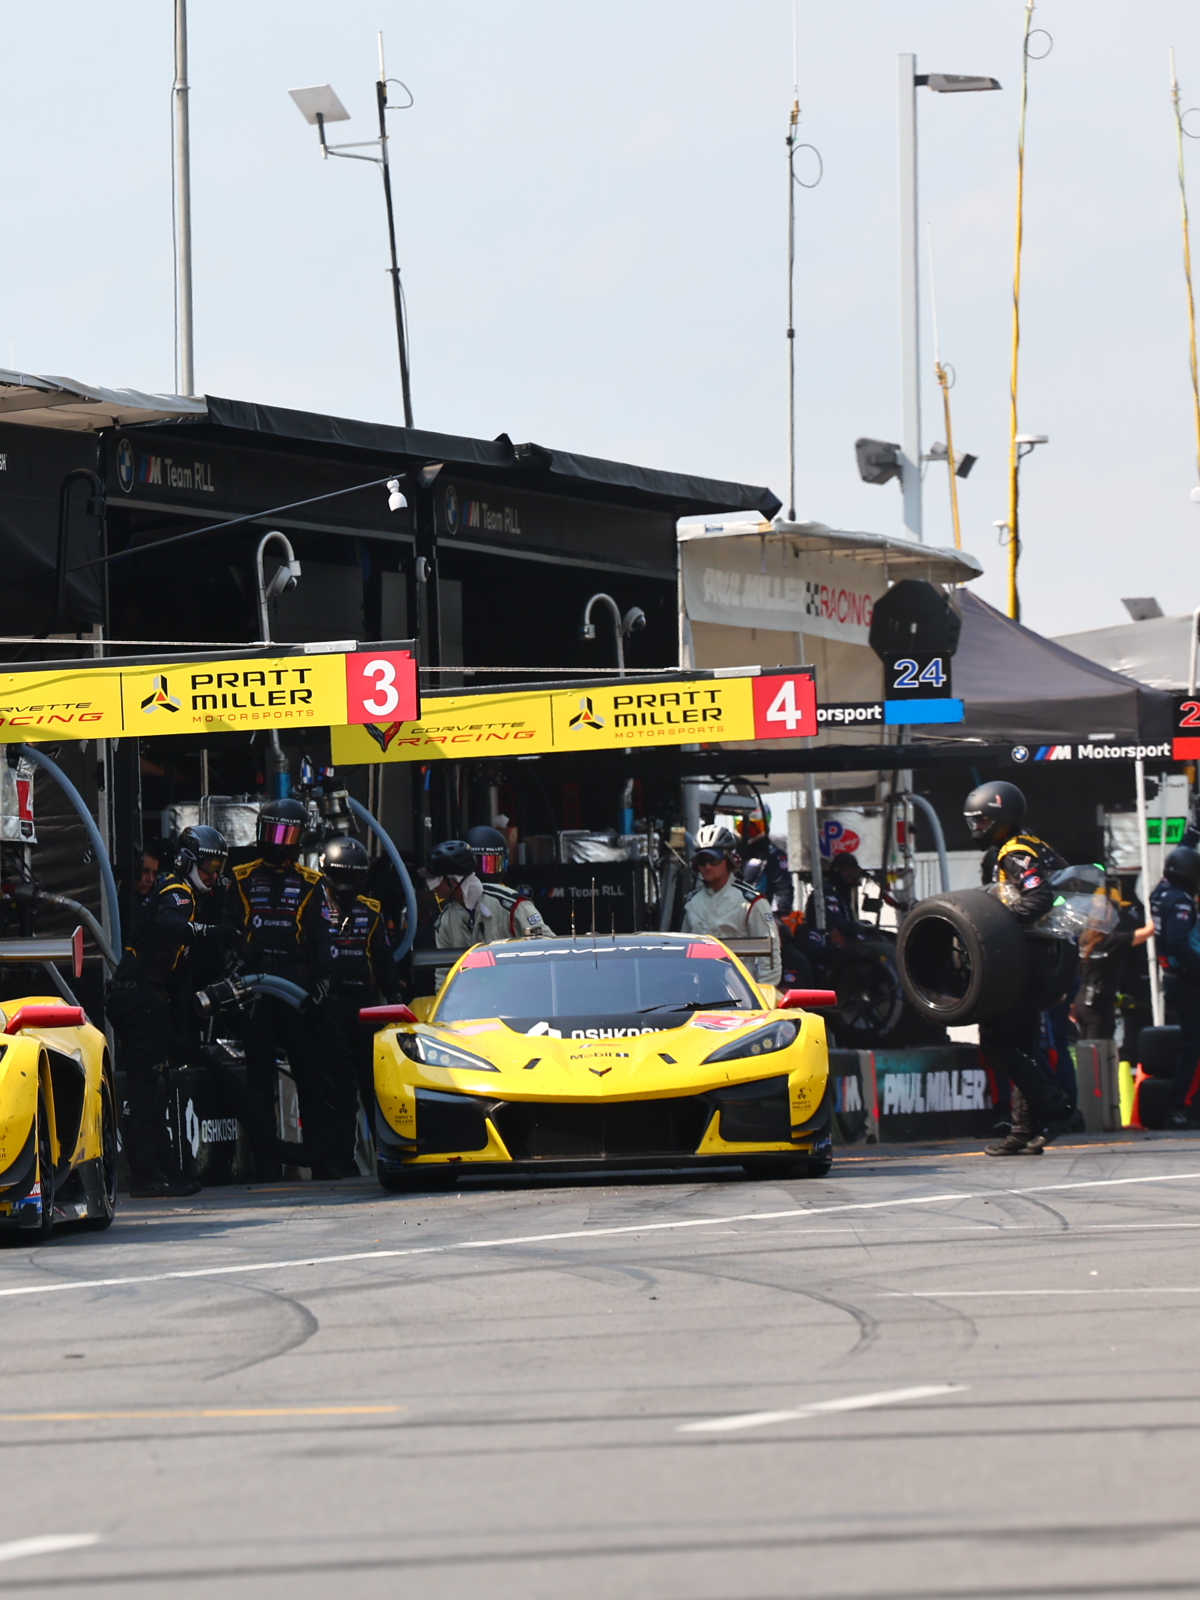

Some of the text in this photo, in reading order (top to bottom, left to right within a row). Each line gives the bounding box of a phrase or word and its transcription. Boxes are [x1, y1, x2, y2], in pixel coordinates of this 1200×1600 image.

[164, 458, 193, 489] Team
[194, 462, 214, 491] RLL
[820, 585, 873, 627] RACING
[191, 668, 312, 690] PRATT
[893, 657, 947, 688] 24
[362, 659, 399, 716] 3
[191, 688, 312, 711] MILLER
[613, 689, 722, 710] PRATT
[766, 680, 802, 730] 4
[192, 709, 315, 723] MOTORSPORTS
[614, 707, 722, 728] MILLER
[411, 721, 526, 734] CORVETTE
[615, 725, 725, 739] MOTORSPORTS
[397, 730, 537, 747] RACING
[1078, 742, 1171, 760] Motorsport
[568, 886, 599, 897] Team
[602, 885, 625, 896] RLL
[496, 946, 685, 958] CORVETTE
[883, 1073, 924, 1115] PAUL
[201, 1118, 238, 1143] OSHKOSH
